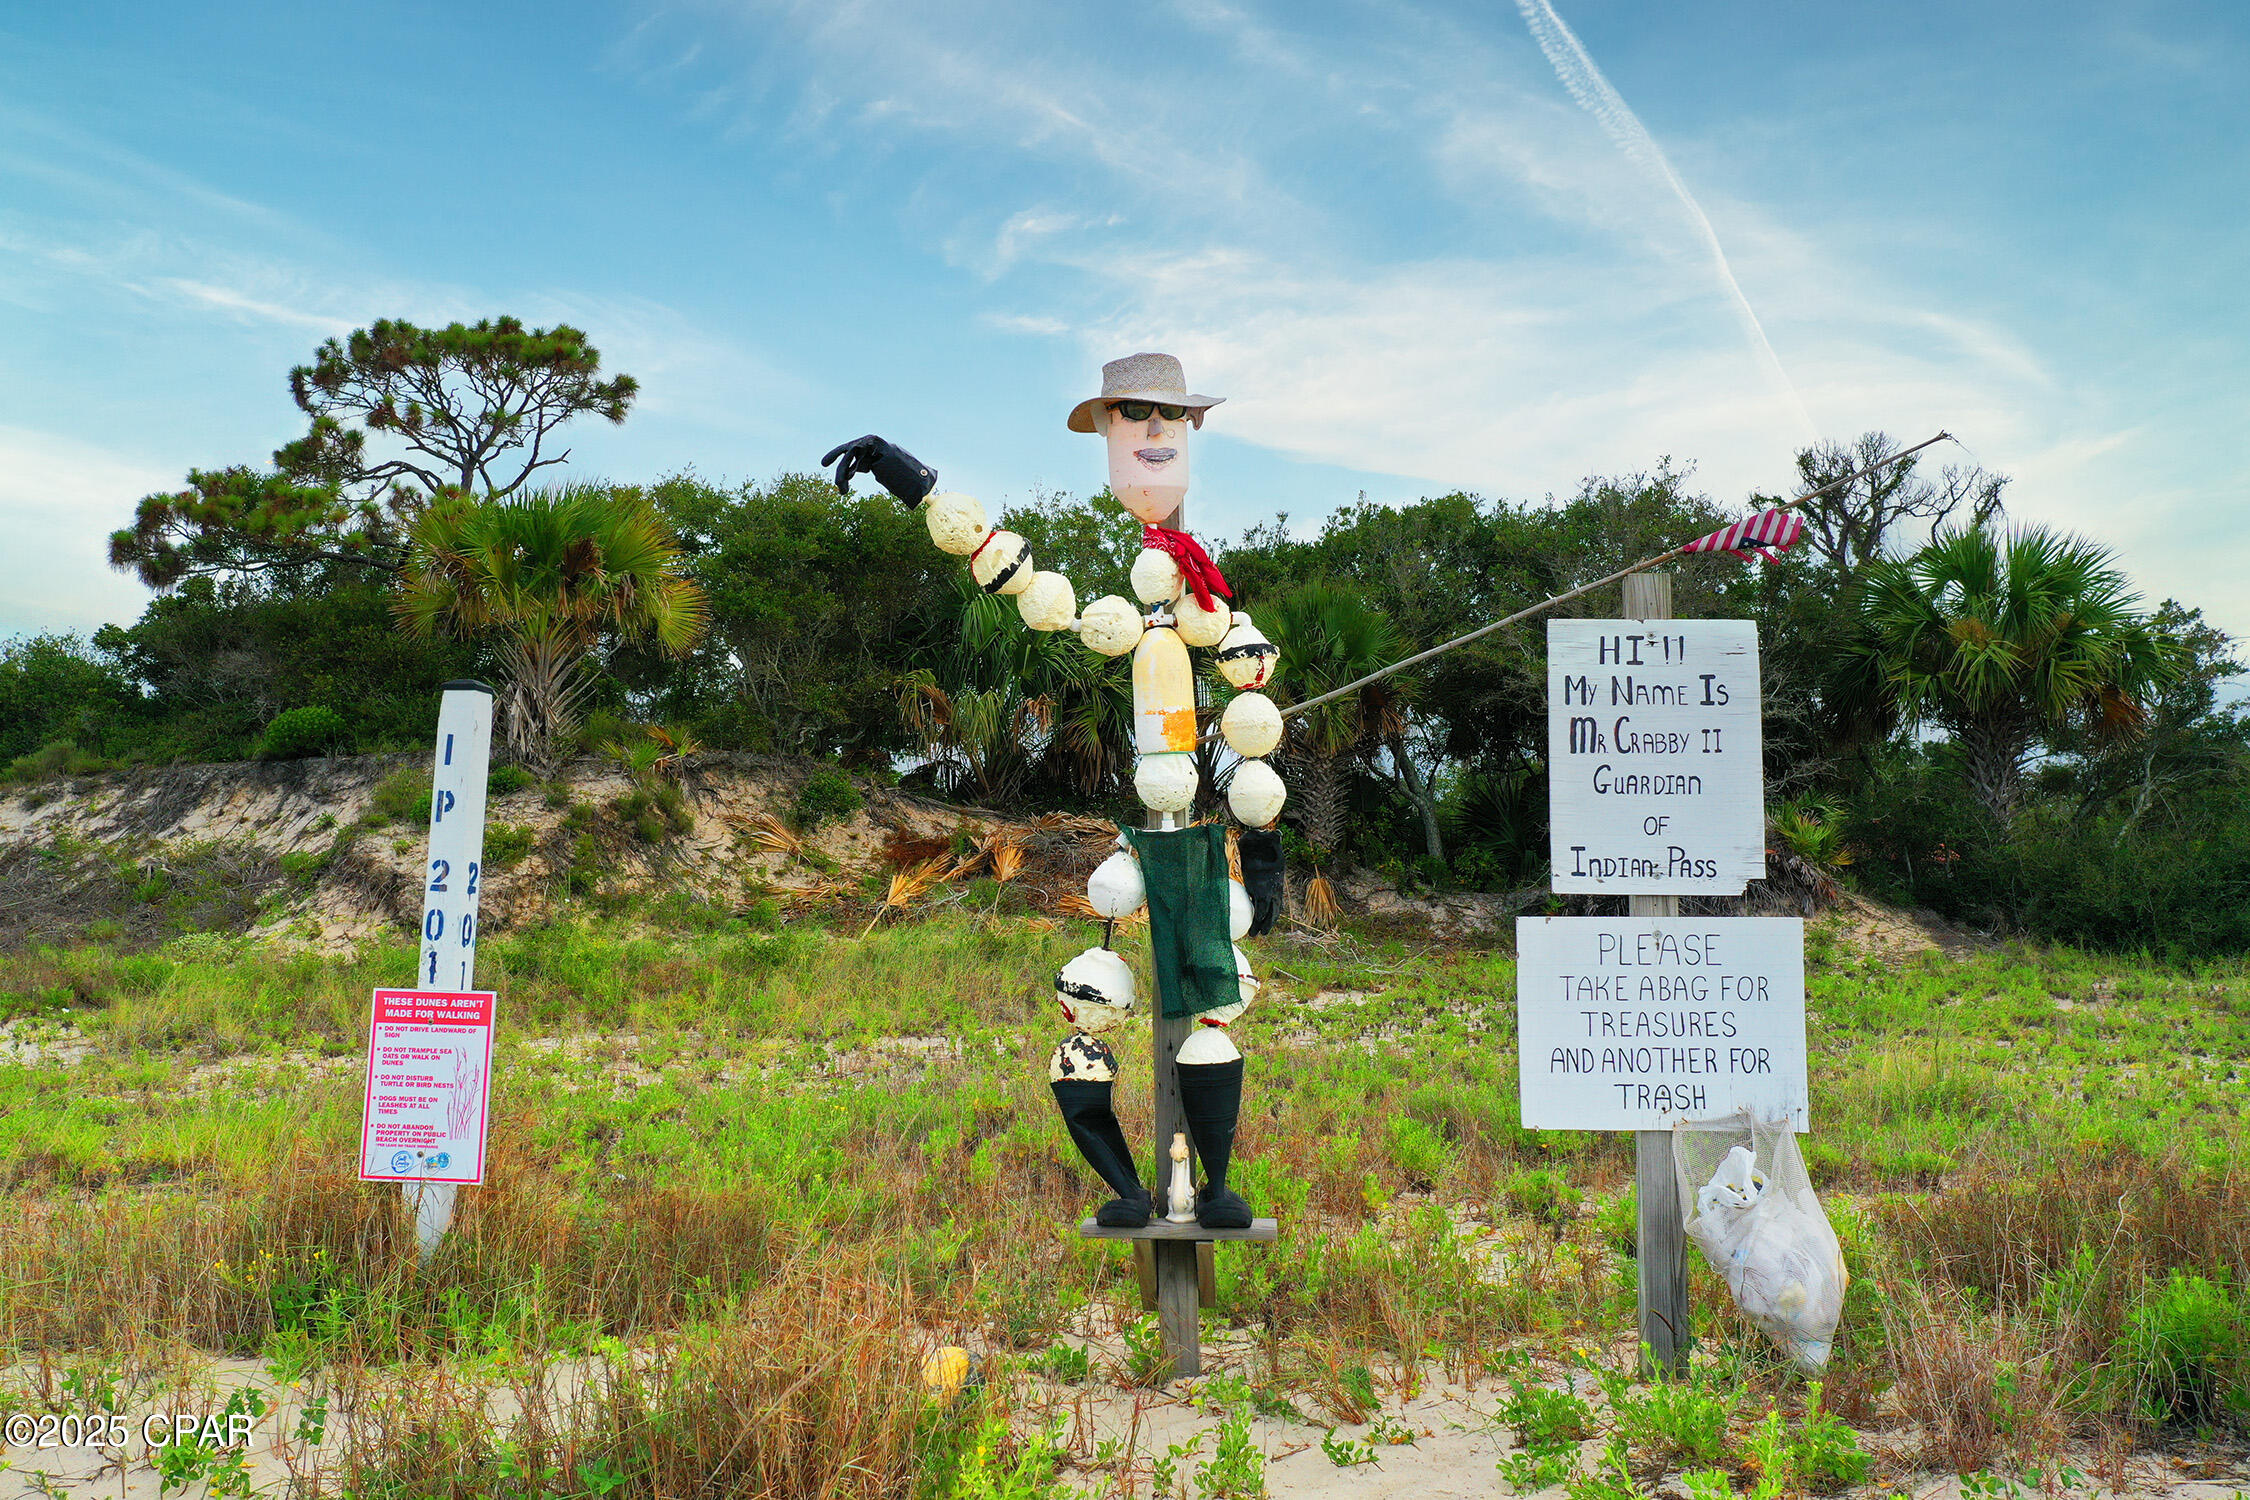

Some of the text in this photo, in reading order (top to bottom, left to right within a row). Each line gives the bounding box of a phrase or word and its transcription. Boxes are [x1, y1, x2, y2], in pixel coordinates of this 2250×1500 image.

[1564, 674, 1729, 706] MY NAME IS
[1614, 716, 1690, 754] CRABBY
[1701, 728, 1722, 754] II
[1593, 764, 1702, 795] GUARDIAN
[1643, 816, 1670, 836] OF
[1570, 846, 1718, 878] INDIAN PASS
[1598, 933, 1722, 966] PLEASE
[1560, 975, 1629, 1002] TAKE
[1721, 975, 1769, 1002] FOR
[384, 997, 484, 1008] THESE DUNES AREN'T
[385, 1009, 480, 1020] MADE FOR WALKING
[1581, 1011, 1737, 1038] TREASURES
[1550, 1047, 1771, 1074] AND ANOTHER FOR
[1614, 1084, 1706, 1110] TRASH
